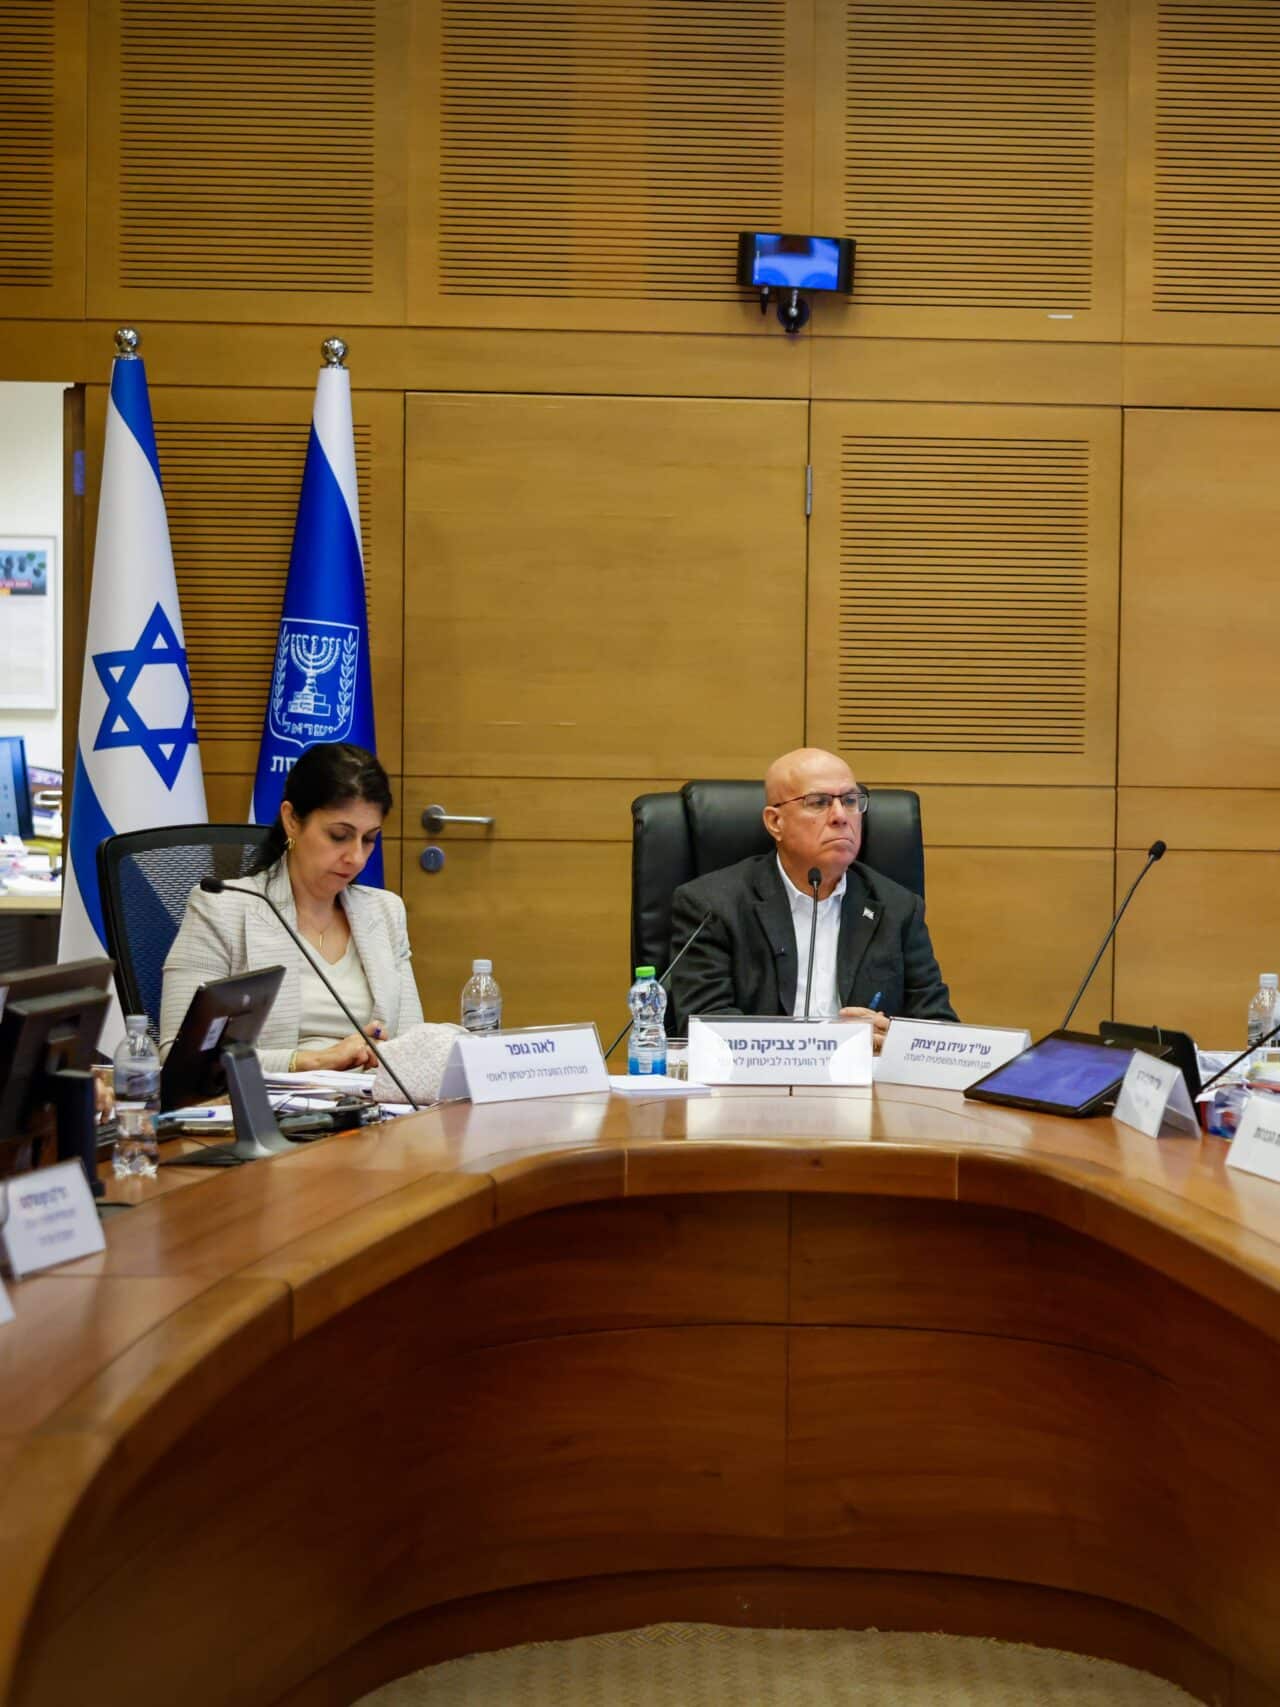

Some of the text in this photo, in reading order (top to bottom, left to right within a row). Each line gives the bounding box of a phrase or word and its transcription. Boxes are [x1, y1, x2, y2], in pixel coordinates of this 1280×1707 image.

[281, 712, 334, 737] ישראל
[505, 1039, 555, 1055] לאה גופר
[727, 1038, 748, 1050] פוג
[751, 1038, 794, 1053] צביקה
[911, 1038, 936, 1050] יצחק
[935, 1039, 946, 1053] בן
[947, 1041, 967, 1053] עידו
[747, 1055, 782, 1069] לביטחון
[784, 1057, 818, 1067] הוועדה
